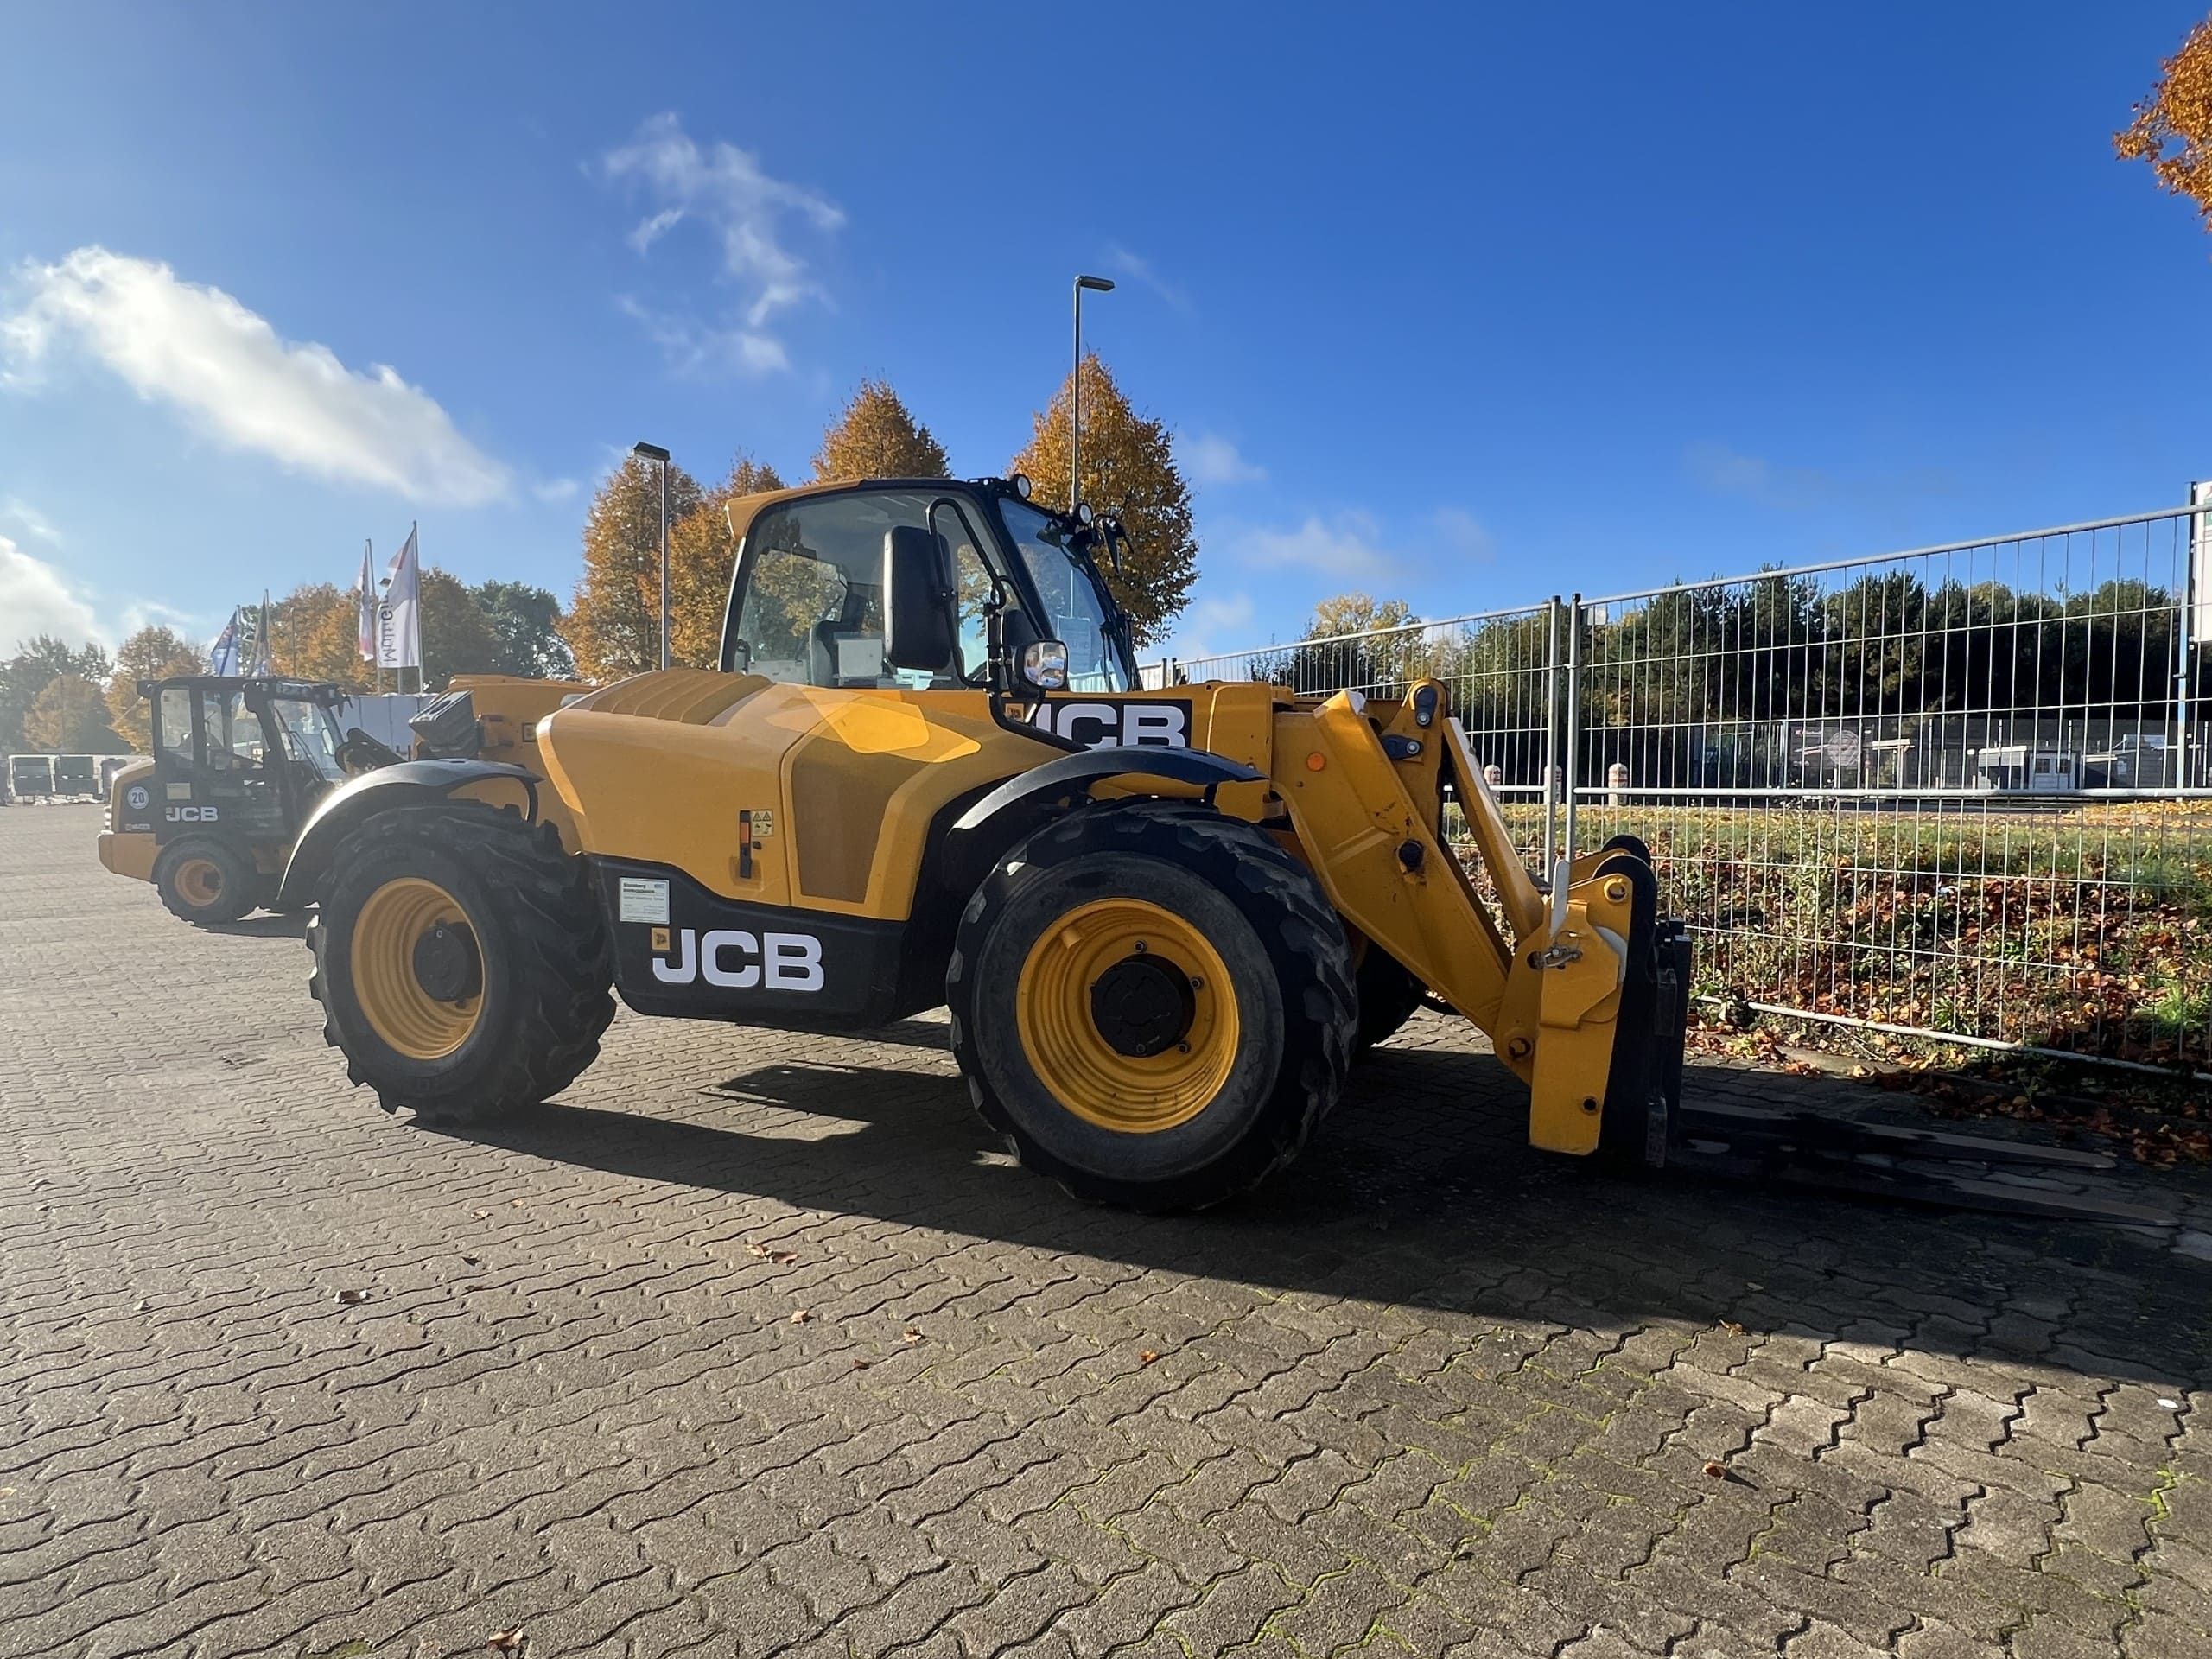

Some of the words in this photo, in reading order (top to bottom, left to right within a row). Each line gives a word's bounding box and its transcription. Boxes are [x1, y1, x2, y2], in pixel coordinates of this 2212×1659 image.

[132, 791, 145, 804] 20
[165, 806, 219, 822] JCB
[652, 928, 825, 991] JCB
